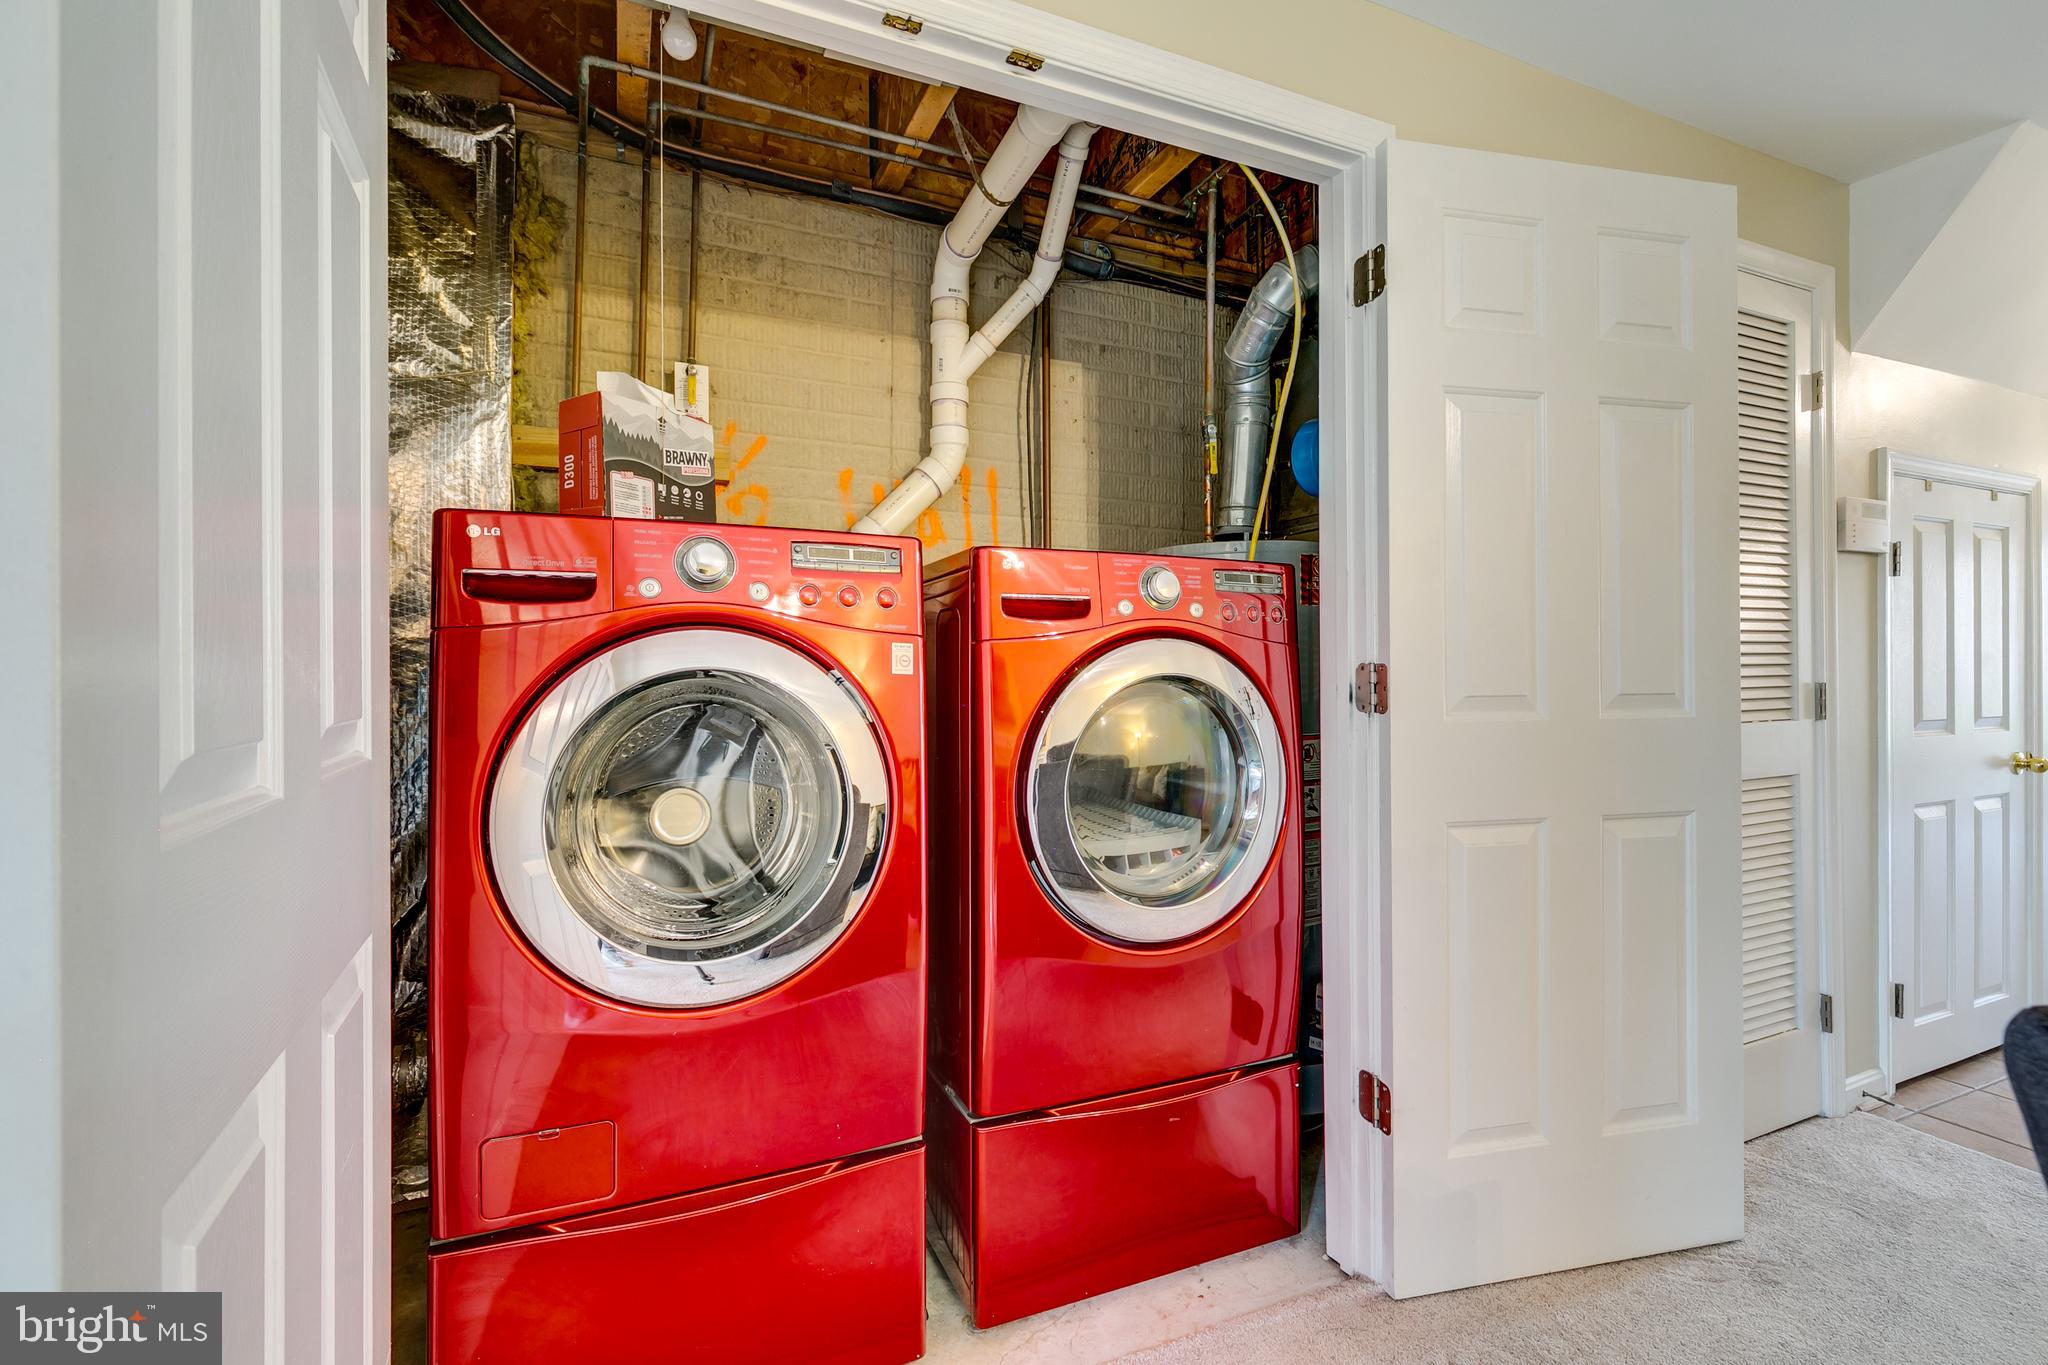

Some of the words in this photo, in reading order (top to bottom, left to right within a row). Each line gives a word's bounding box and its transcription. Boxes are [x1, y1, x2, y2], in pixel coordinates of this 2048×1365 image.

[665, 449, 708, 467] BRAWNY
[563, 454, 575, 489] D300
[483, 526, 501, 536] LG
